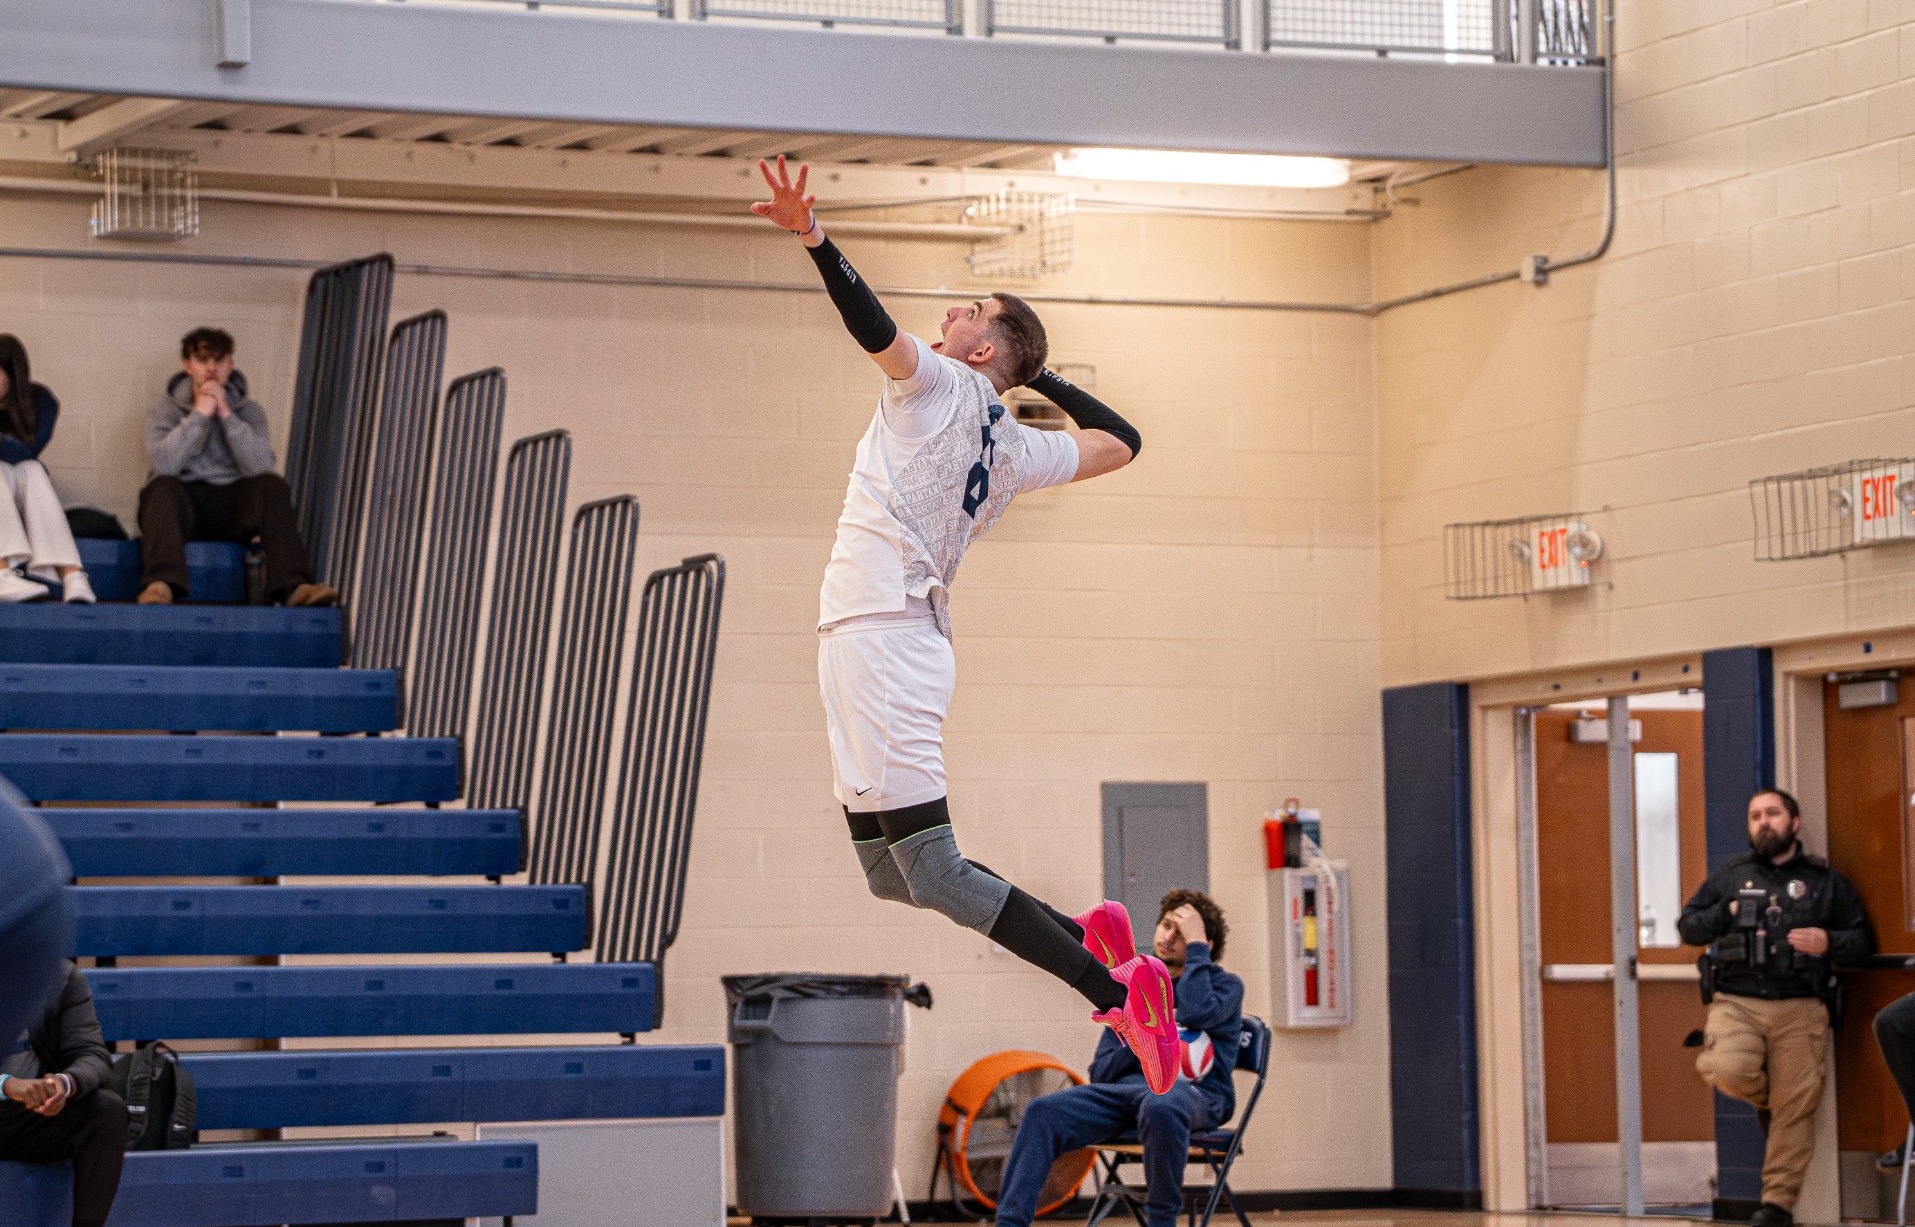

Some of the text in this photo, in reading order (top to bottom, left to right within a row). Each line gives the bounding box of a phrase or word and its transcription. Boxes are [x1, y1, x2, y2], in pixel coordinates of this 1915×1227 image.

[838, 255, 857, 285] KIPSTA
[896, 470, 937, 491] SPARTAN
[1862, 474, 1897, 522] EXIT
[1538, 528, 1568, 570] EXIT
